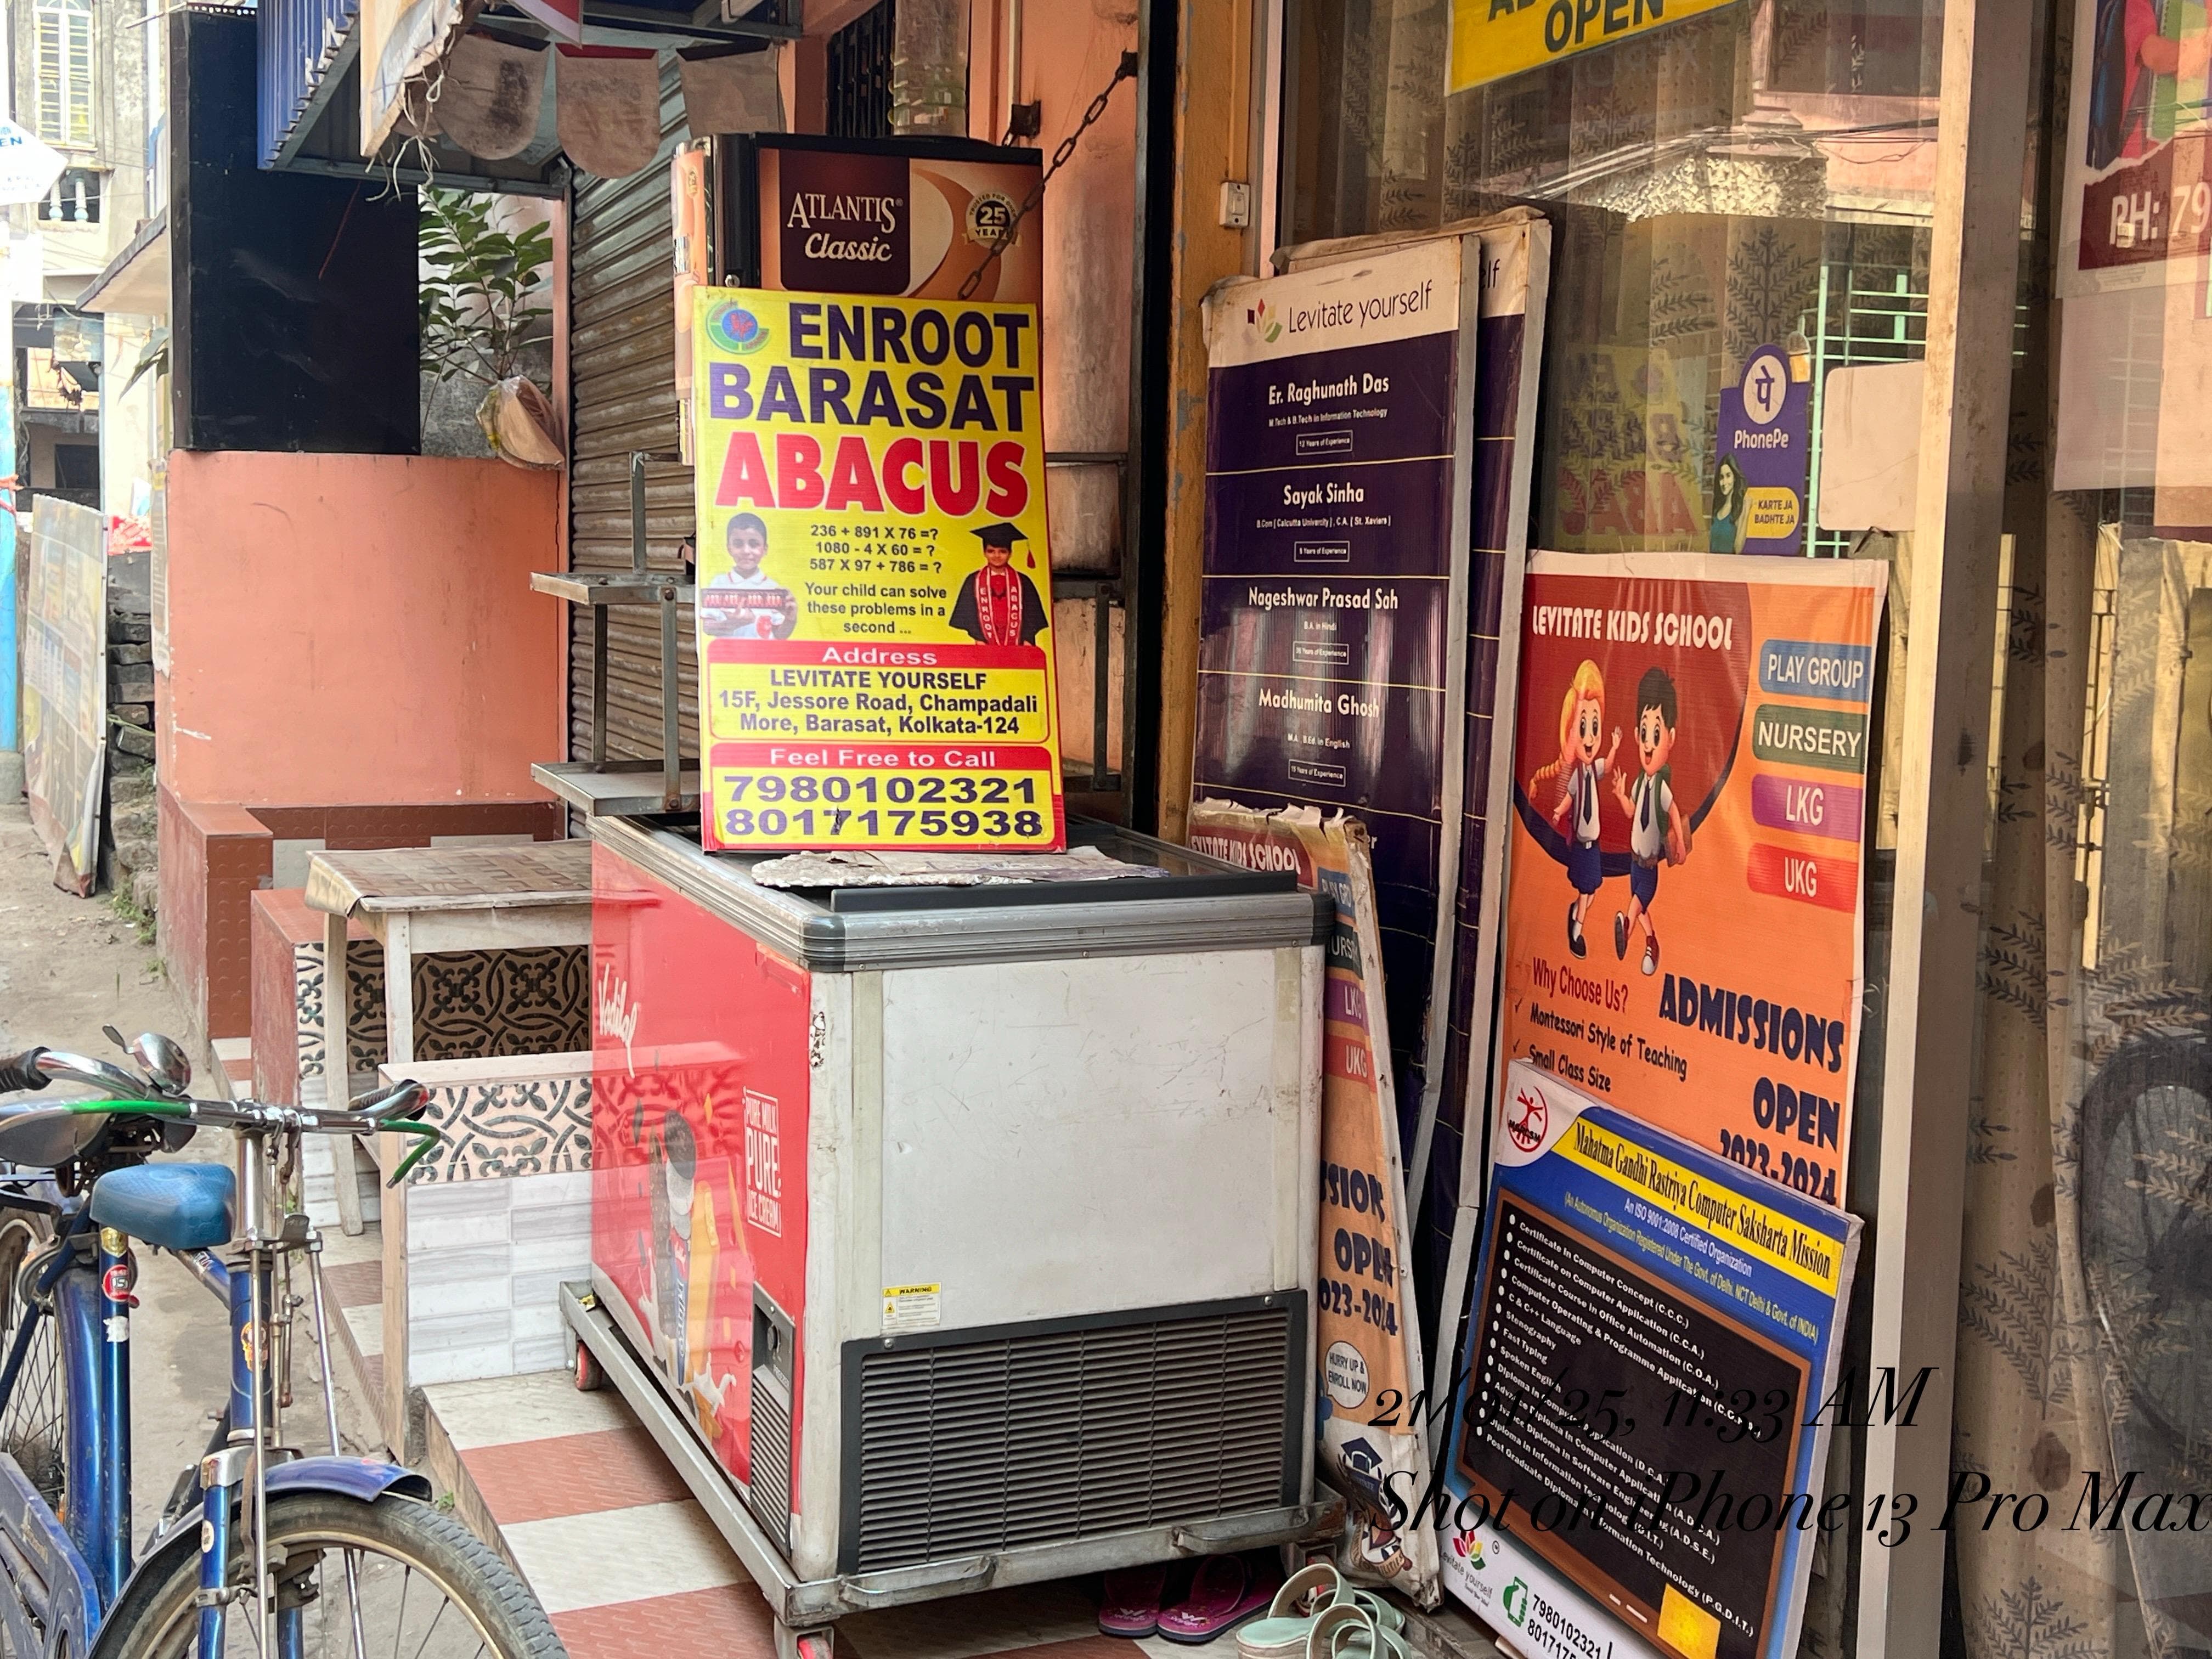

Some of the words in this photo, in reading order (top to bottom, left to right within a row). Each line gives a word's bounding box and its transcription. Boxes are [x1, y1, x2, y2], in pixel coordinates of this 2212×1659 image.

[1545, 0, 1665, 52] OPEN
[787, 192, 896, 234] ATLANTIS
[980, 206, 1006, 224] 25
[805, 232, 892, 261] Classic
[1289, 301, 1353, 334] Levitate
[1358, 279, 1432, 329] yourself
[789, 303, 1030, 369] ENROOT
[709, 362, 1034, 431] BARASAT
[1268, 385, 1284, 405] Er.
[1287, 375, 1357, 405] Raghunath
[1363, 373, 1389, 394] Das
[1756, 365, 1774, 412] पे
[1353, 408, 1388, 419] Technology
[1734, 428, 1788, 449] PhonePe
[715, 431, 1028, 518] ABACUS
[1283, 482, 1323, 510] Sayak
[1327, 482, 1364, 504] Sinha
[1758, 500, 1782, 510] KARTE
[1784, 499, 1792, 510] JA
[811, 524, 837, 537] 236
[855, 526, 878, 538] 891
[899, 527, 916, 539] 76
[1754, 514, 1784, 524] BADHTE
[1786, 514, 1795, 524] JA
[816, 542, 849, 554] 1080
[891, 544, 908, 556] 60
[810, 558, 834, 571] 587
[855, 559, 872, 572] 97
[890, 560, 915, 573] 786
[805, 582, 837, 597] Your
[842, 584, 876, 597] child
[881, 586, 904, 599] can
[909, 586, 947, 599] solve
[1249, 587, 1318, 611] Nageshwar
[1322, 588, 1370, 610] Prasad
[1375, 589, 1398, 610] Sah
[807, 601, 845, 615] these
[850, 603, 916, 619] problems
[921, 604, 933, 617] in
[938, 607, 945, 617] a
[1009, 586, 1018, 636] ABACUS
[843, 620, 895, 634] second
[1532, 605, 1602, 639] LEVITATE
[1607, 610, 1649, 644] KIDS
[1654, 613, 1733, 651] SCHOOL
[822, 647, 938, 665] Address
[1768, 654, 1805, 683] PLAY
[1808, 657, 1864, 689] GROUP
[771, 669, 871, 688] LEVITATE
[878, 672, 987, 690] YOURSELF
[719, 690, 760, 712] 15F,
[767, 691, 849, 710] Jessore
[857, 693, 913, 714] Road,
[920, 695, 1037, 716] Champadali
[1259, 689, 1332, 714] Madhumita
[1338, 695, 1380, 718] Ghosh
[741, 713, 798, 733] More,
[806, 714, 891, 736] Barasat,
[899, 716, 1018, 734] Kolkata-124
[1758, 721, 1862, 758] NURSERY
[770, 749, 827, 765] Feel
[839, 749, 899, 766] Free
[909, 752, 935, 766] to
[944, 751, 995, 768] Call
[1325, 738, 1350, 749] English
[724, 776, 1034, 803] 7980102321
[1786, 785, 1824, 826] LKG
[726, 809, 1042, 837] 8017175938
[1249, 843, 1301, 874] SCHOOL
[1785, 857, 1817, 897] UKG
[1533, 957, 1556, 992] Why
[1559, 966, 1602, 1005] Choose
[1605, 983, 1629, 1014] Us?
[1659, 973, 1844, 1073] ADMISSIONS
[1530, 1003, 1585, 1042] Montessori
[1588, 1023, 1616, 1052] Style
[1637, 1038, 1687, 1082] Teaching
[1346, 1045, 1367, 1078] UKG
[1528, 1043, 1555, 1072] Small
[1558, 1056, 1585, 1084] Class
[1588, 1065, 1611, 1093] Size
[1753, 1077, 1840, 1153] OPEN
[746, 1126, 779, 1198] PURE
[1573, 1122, 1613, 1168] Mahatma
[1616, 1143, 1648, 1186] Gandhi
[1648, 1158, 1686, 1210] Rastriya
[1689, 1180, 1737, 1229] Computer
[1737, 1204, 1788, 1257] Saksharta
[1789, 1229, 1830, 1279] Mission
[1635, 1203, 1646, 1220] ISO
[1680, 1227, 1708, 1254] Certified
[1708, 1242, 1752, 1277] Organization
[1520, 1222, 1561, 1252] Certificate
[1573, 1254, 1615, 1284] Computer
[1617, 1279, 1654, 1307] Concept
[900, 1286, 932, 1295] WARNING
[1517, 1240, 1559, 1271] Certificate
[1573, 1274, 1615, 1304] Computer
[1616, 1300, 1668, 1337] Application
[1512, 1276, 1550, 1305] Computer
[1552, 1301, 1593, 1334] Operating
[1604, 1333, 1655, 1372] Programme
[1514, 1258, 1556, 1289] Certificate
[1558, 1285, 1587, 1308] Course
[1599, 1310, 1626, 1331] Office
[1627, 1327, 1681, 1365] Automation
[1506, 1311, 1556, 1350] Stenography
[1541, 1313, 1581, 1345] Language
[1500, 1346, 1530, 1371] Spoken
[1503, 1328, 1520, 1345] Fast
[1522, 1340, 1548, 1364] Typing
[1329, 1370, 1350, 1390] ENROLL
[1350, 1358, 1358, 1372] UP
[1498, 1363, 1530, 1392] Diploma
[1527, 1424, 1560, 1453] Diploma
[1572, 1457, 1611, 1489] Software
[1532, 1448, 1581, 1489] Information
[1576, 1438, 1617, 1473] Computer
[1487, 1434, 1504, 1453] Post
[1505, 1449, 1543, 1481] Graduate
[1544, 1477, 1578, 1508] Diploma
[1646, 1551, 1700, 1598] Technology
[1465, 1571, 1493, 1599] yourself
